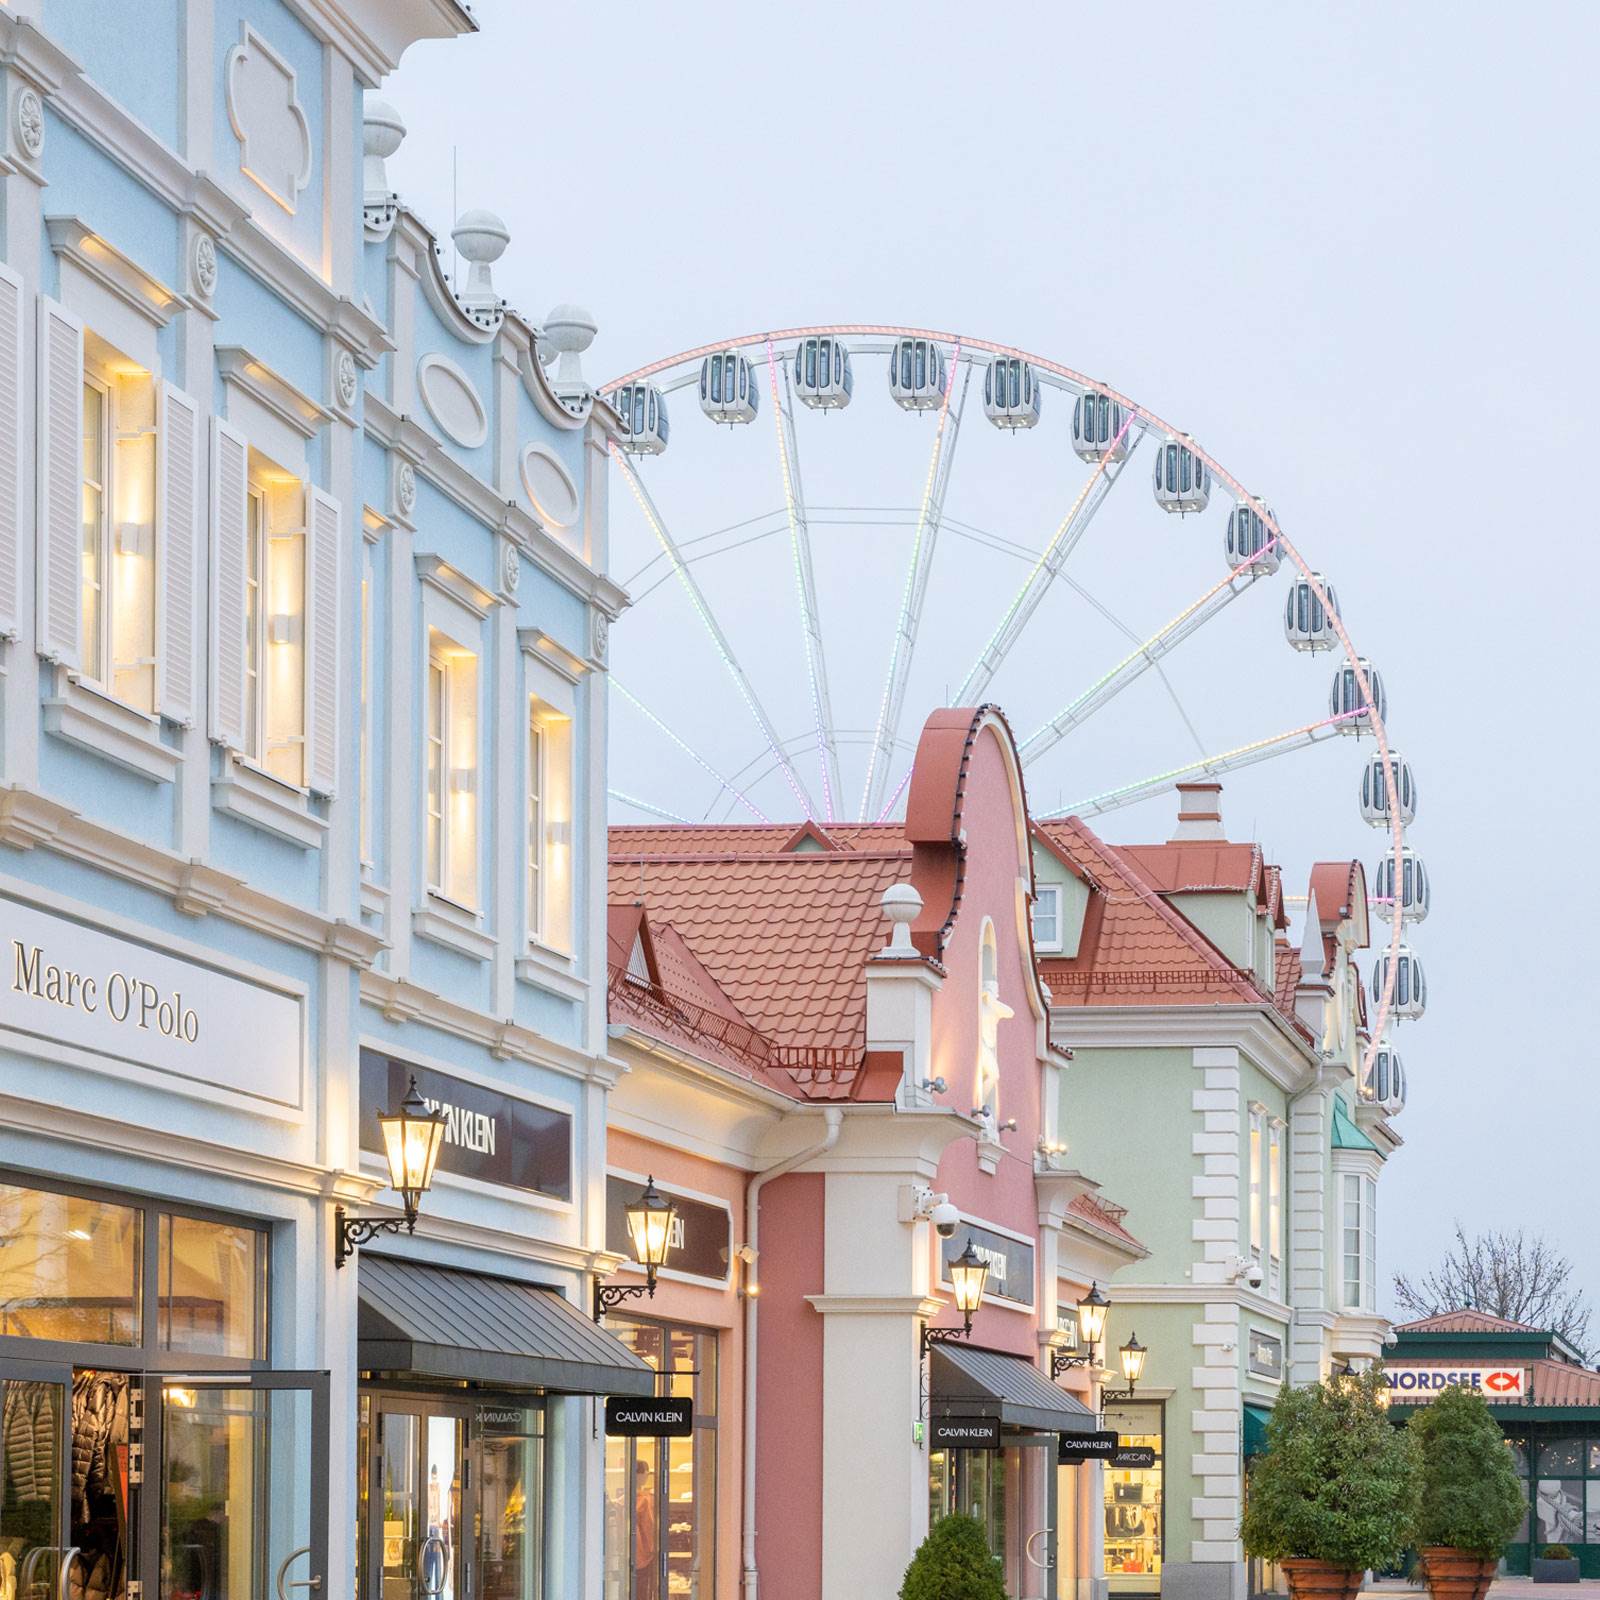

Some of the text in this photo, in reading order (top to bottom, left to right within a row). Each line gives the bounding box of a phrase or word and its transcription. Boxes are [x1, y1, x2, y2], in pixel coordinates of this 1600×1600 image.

[11, 939, 199, 1043] Marc O'Polo
[615, 1411, 683, 1422] CALVIN KLEIN
[938, 1427, 993, 1437] CALVIN KLEIN
[1065, 1440, 1112, 1449] CALVIN KLEIN
